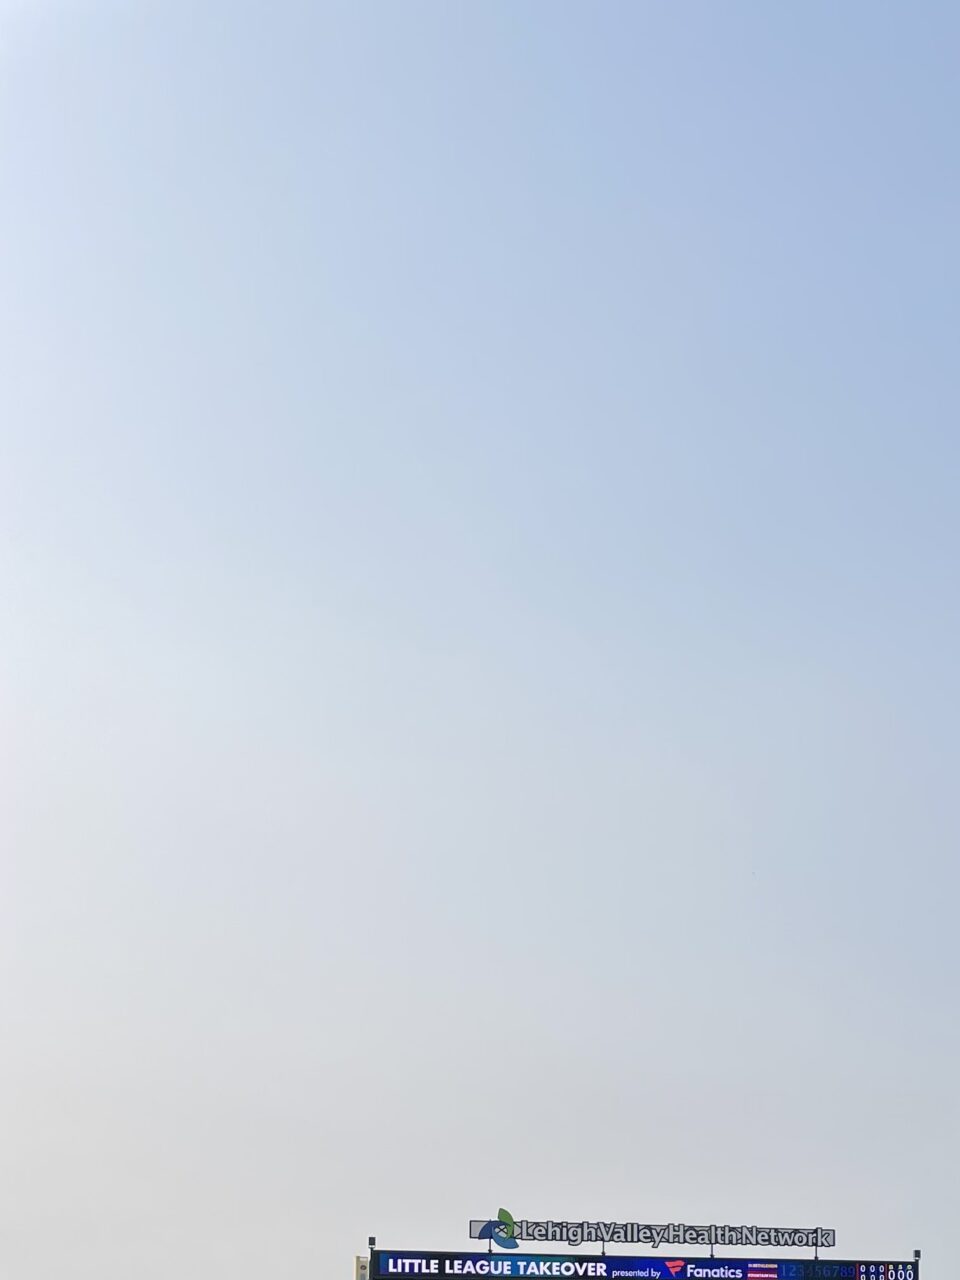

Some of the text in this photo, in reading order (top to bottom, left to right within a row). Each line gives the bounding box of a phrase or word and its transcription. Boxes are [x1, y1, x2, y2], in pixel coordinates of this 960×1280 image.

[388, 1258, 743, 1279] LITTLE LEAGUE TAKEOVER presented by Fanatics
